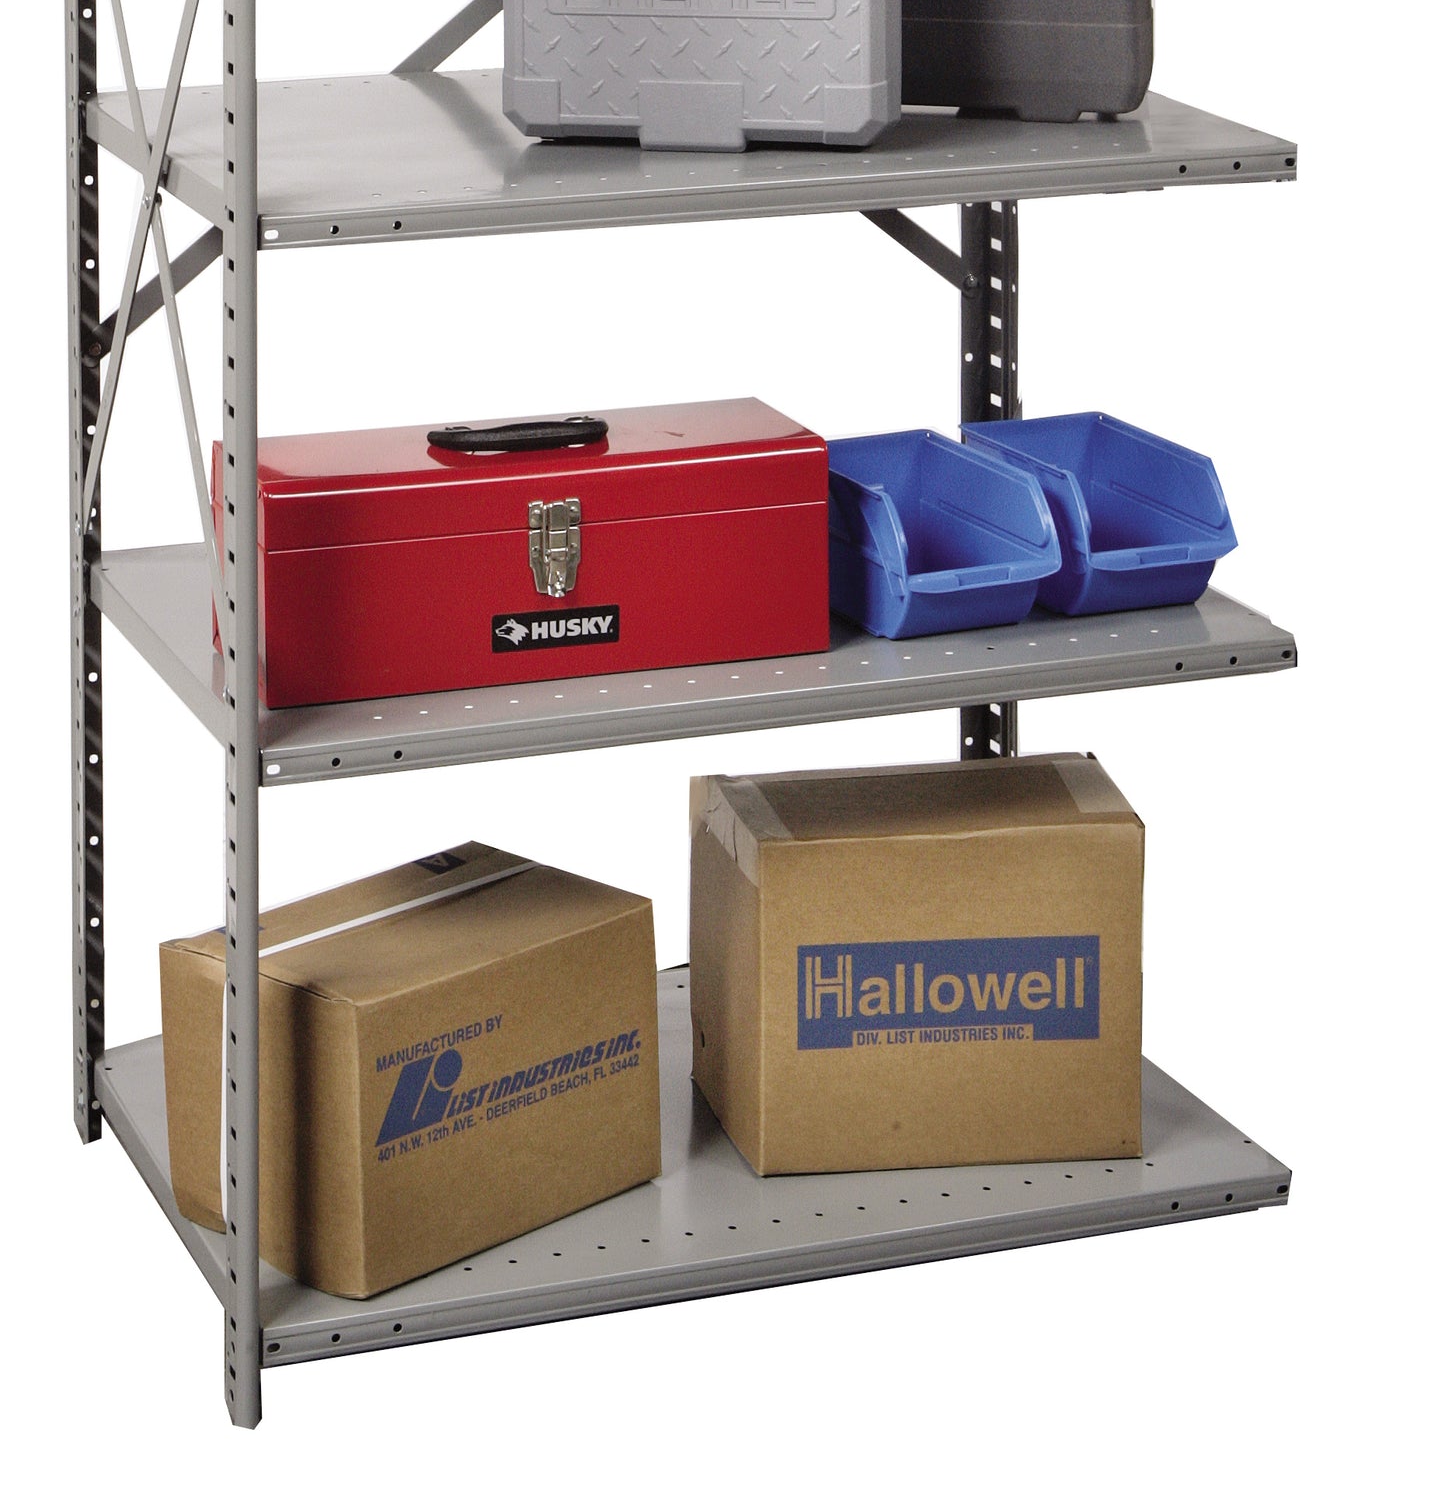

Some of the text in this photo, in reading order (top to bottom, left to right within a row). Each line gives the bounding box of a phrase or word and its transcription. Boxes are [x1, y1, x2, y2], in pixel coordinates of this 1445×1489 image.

[805, 955, 1085, 1020] Hallowell
[376, 1014, 503, 1072] MANUFACTURED BY
[857, 1026, 1030, 1046] DIV. LIST INDUSTRIES INC.
[378, 1144, 396, 1162] 401
[400, 1134, 424, 1155] N.W.
[427, 1125, 449, 1143] 12th
[452, 1114, 477, 1135] AVE.
[486, 1087, 548, 1121] DEERFIELD
[550, 1072, 592, 1097] BEACH,
[593, 1066, 607, 1081] FL
[610, 1054, 640, 1075] 33442
